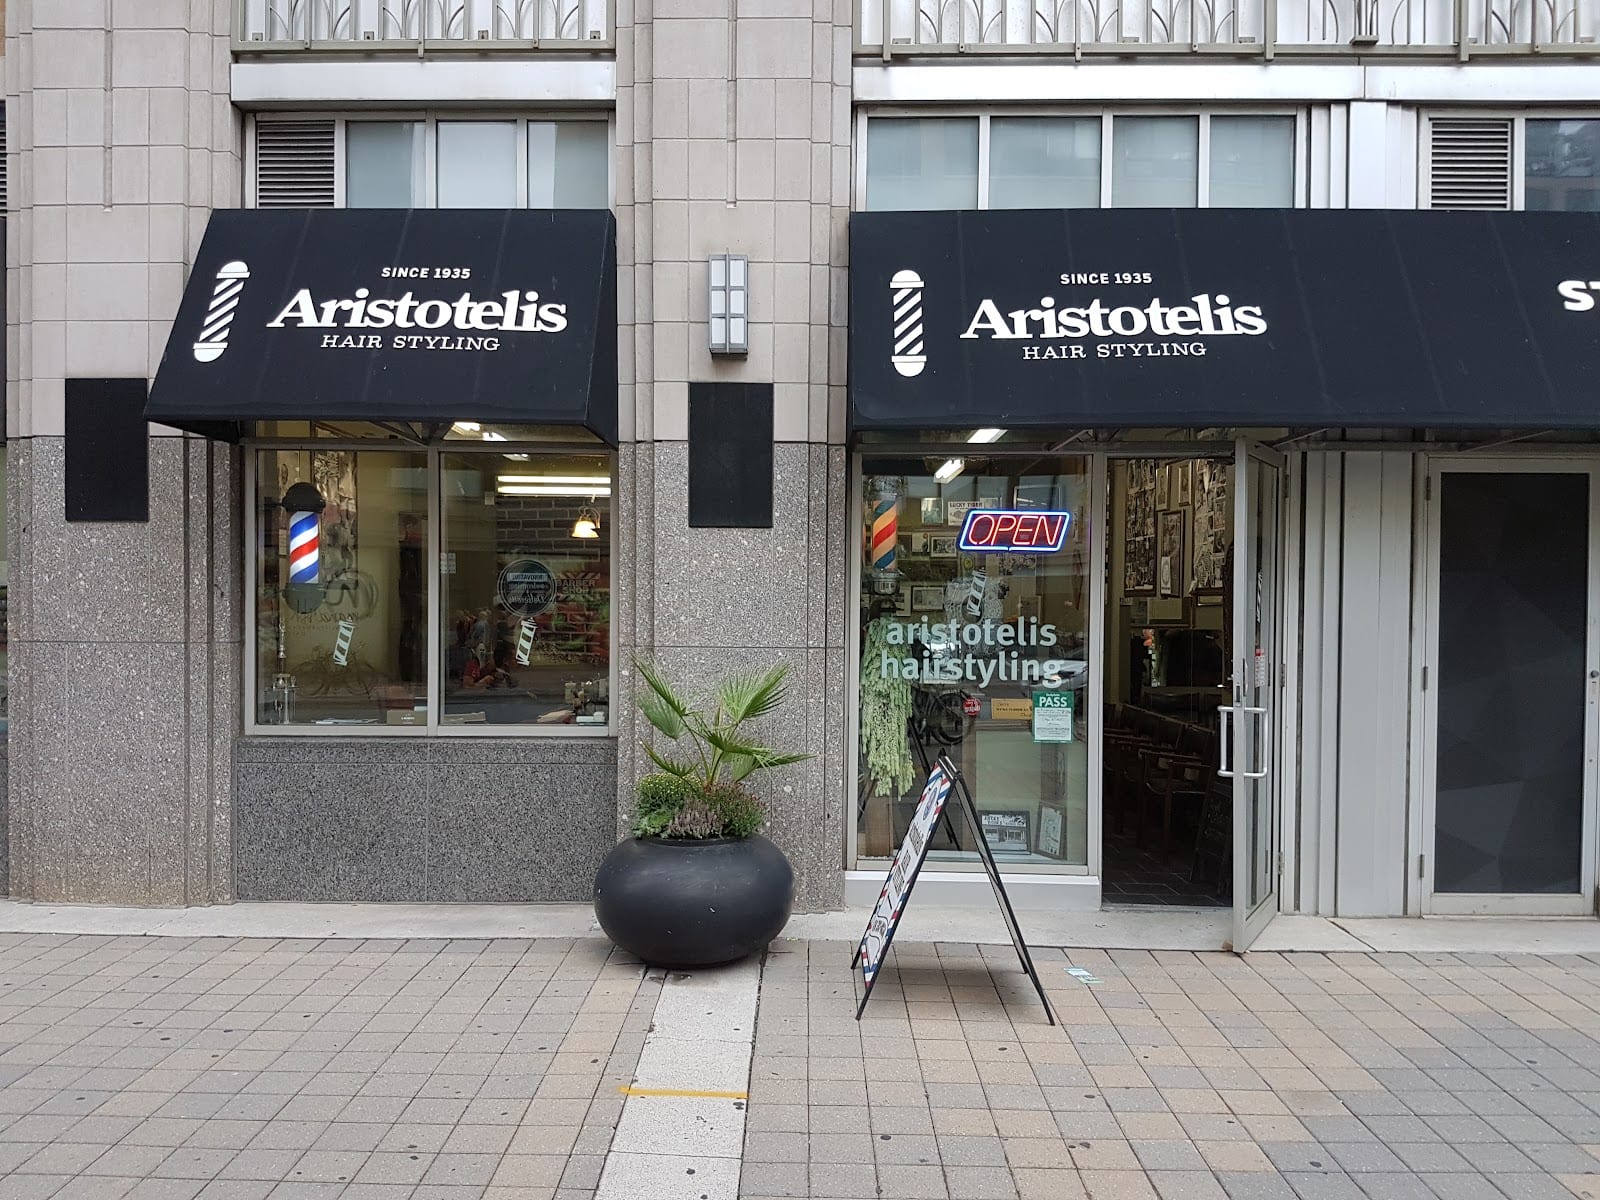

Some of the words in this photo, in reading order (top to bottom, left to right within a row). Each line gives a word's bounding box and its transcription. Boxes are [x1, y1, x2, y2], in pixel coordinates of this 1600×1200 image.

[381, 266, 430, 279] SINCE
[433, 267, 471, 280] 1935
[1060, 272, 1110, 285] SINCE
[1114, 272, 1153, 285] 1935
[266, 287, 568, 333] Aristotelis
[960, 293, 1268, 339] Aristotelis
[320, 334, 383, 349] HAIR
[392, 335, 501, 351] STYLING
[1022, 345, 1087, 360] HAIR
[1096, 342, 1207, 358] STYLING
[968, 514, 1062, 546] OPEN
[555, 579, 596, 587] BARBER
[886, 616, 1057, 646] aristotelis
[881, 650, 1065, 688] hairstyling
[1039, 696, 1068, 707] PASS
